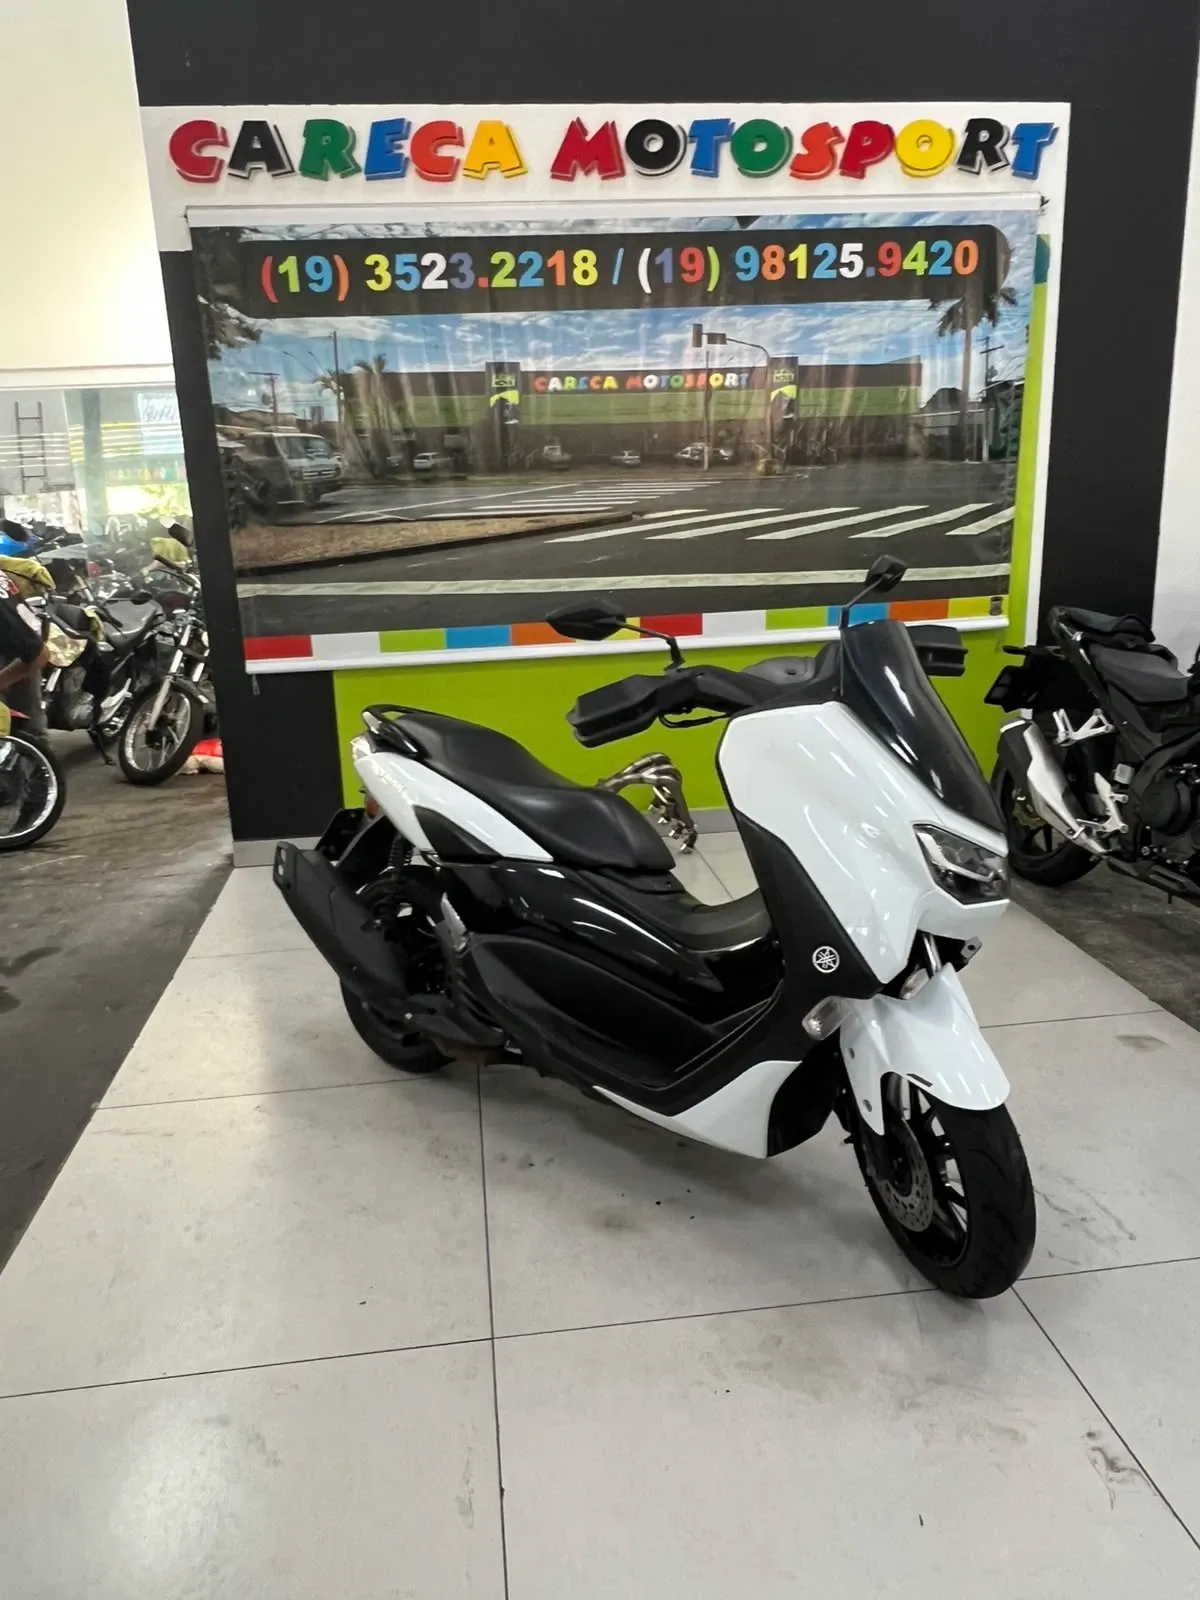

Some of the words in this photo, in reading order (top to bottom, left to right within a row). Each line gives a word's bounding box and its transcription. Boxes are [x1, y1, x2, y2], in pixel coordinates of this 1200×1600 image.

[169, 117, 528, 183] CARECA
[550, 116, 1059, 182] MOTOSPORT
[261, 254, 349, 303] (19)
[365, 250, 598, 292] 3523.2218
[637, 246, 720, 294] (19)
[735, 240, 979, 282] 98125.9420
[534, 375, 618, 392] CARECA
